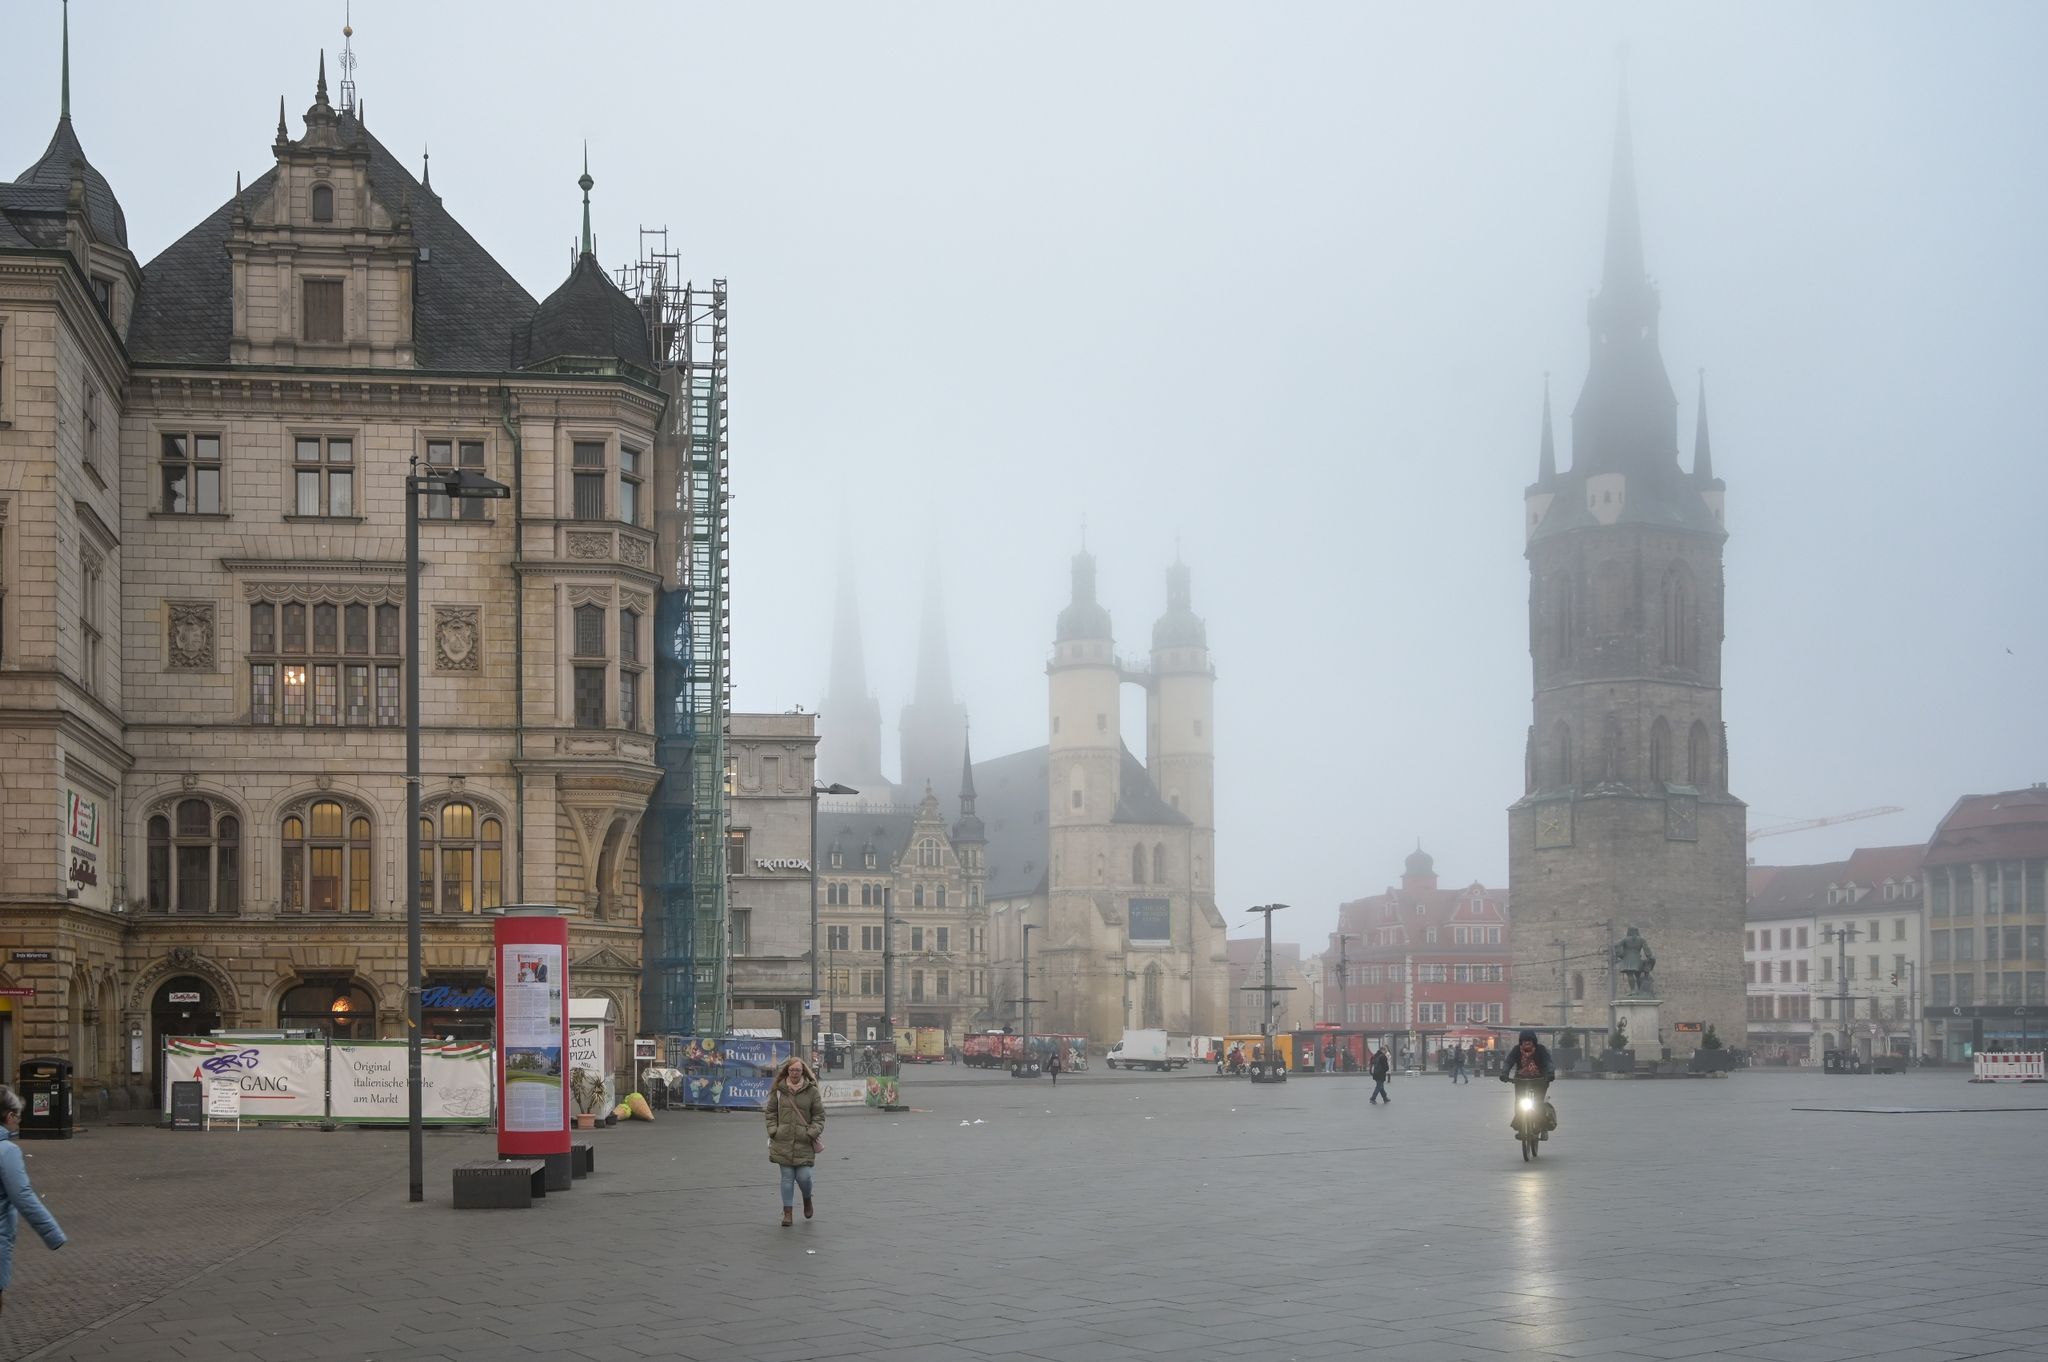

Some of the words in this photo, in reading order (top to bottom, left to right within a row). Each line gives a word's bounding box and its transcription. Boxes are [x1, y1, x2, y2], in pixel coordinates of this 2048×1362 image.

[570, 1050, 597, 1061] PIZZA
[726, 1049, 766, 1061] RIALTO
[353, 1061, 391, 1074] Original
[240, 1075, 288, 1092] GANG
[353, 1077, 404, 1088] italienische
[729, 1086, 768, 1098] RIALTO
[353, 1096, 369, 1104] am
[370, 1094, 399, 1105] Markt
